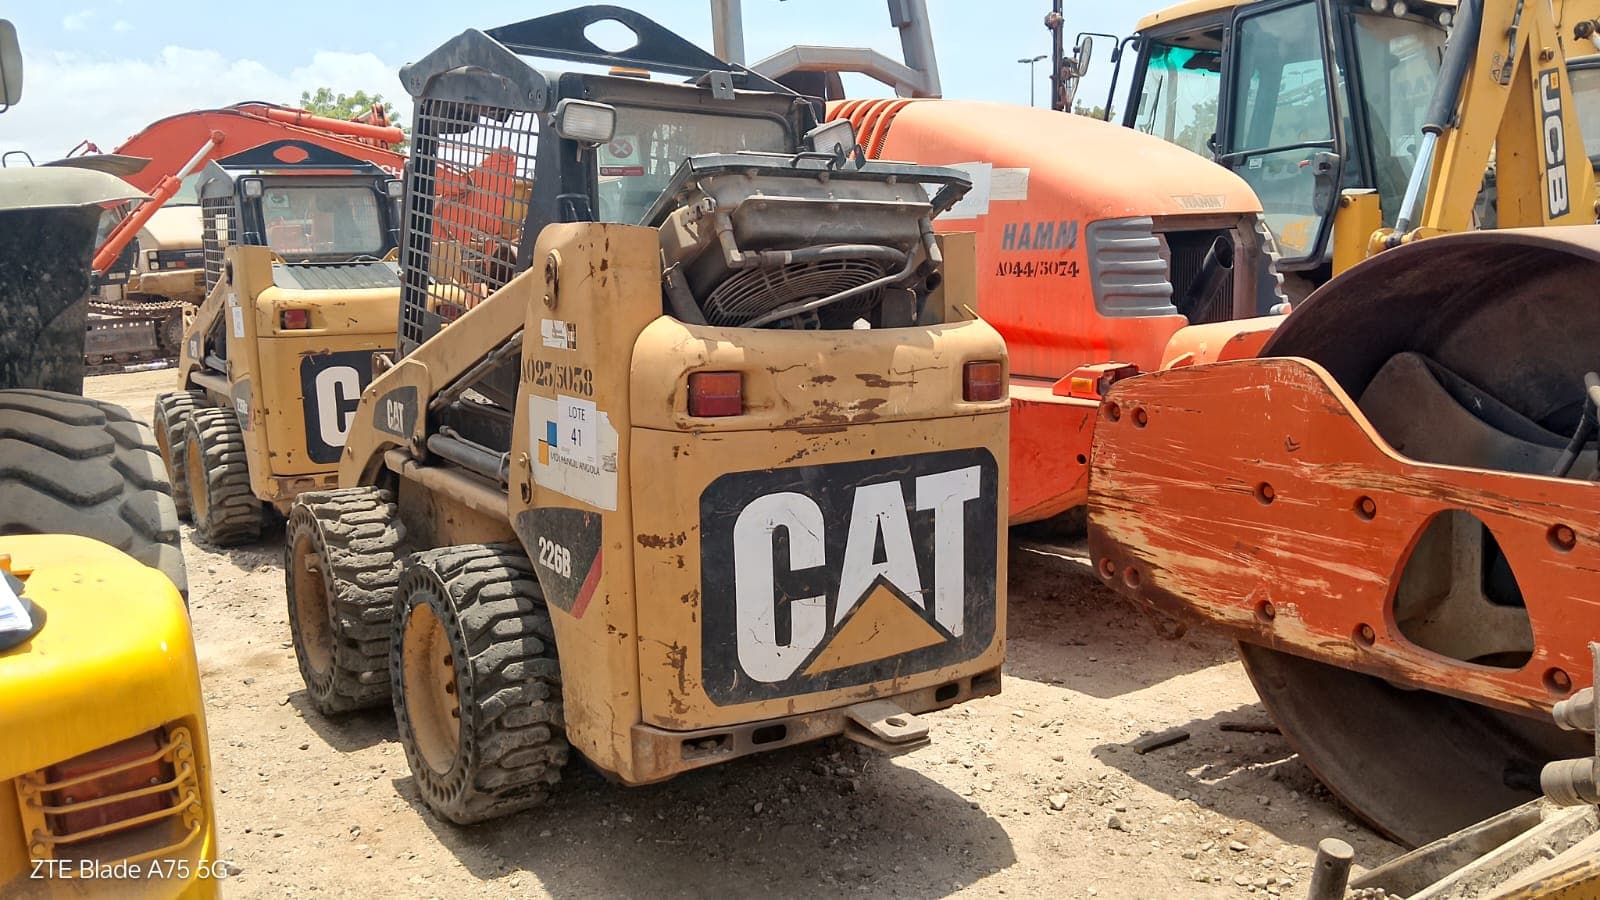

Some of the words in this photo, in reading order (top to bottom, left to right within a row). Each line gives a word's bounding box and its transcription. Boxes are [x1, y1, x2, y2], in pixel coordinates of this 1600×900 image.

[1541, 72, 1568, 215] JCB
[1002, 221, 1078, 250] HAMM
[387, 399, 404, 433] CAT
[568, 405, 586, 421] LOTE
[571, 428, 582, 447] 41
[538, 536, 571, 579] 226B
[733, 465, 981, 683] CAT
